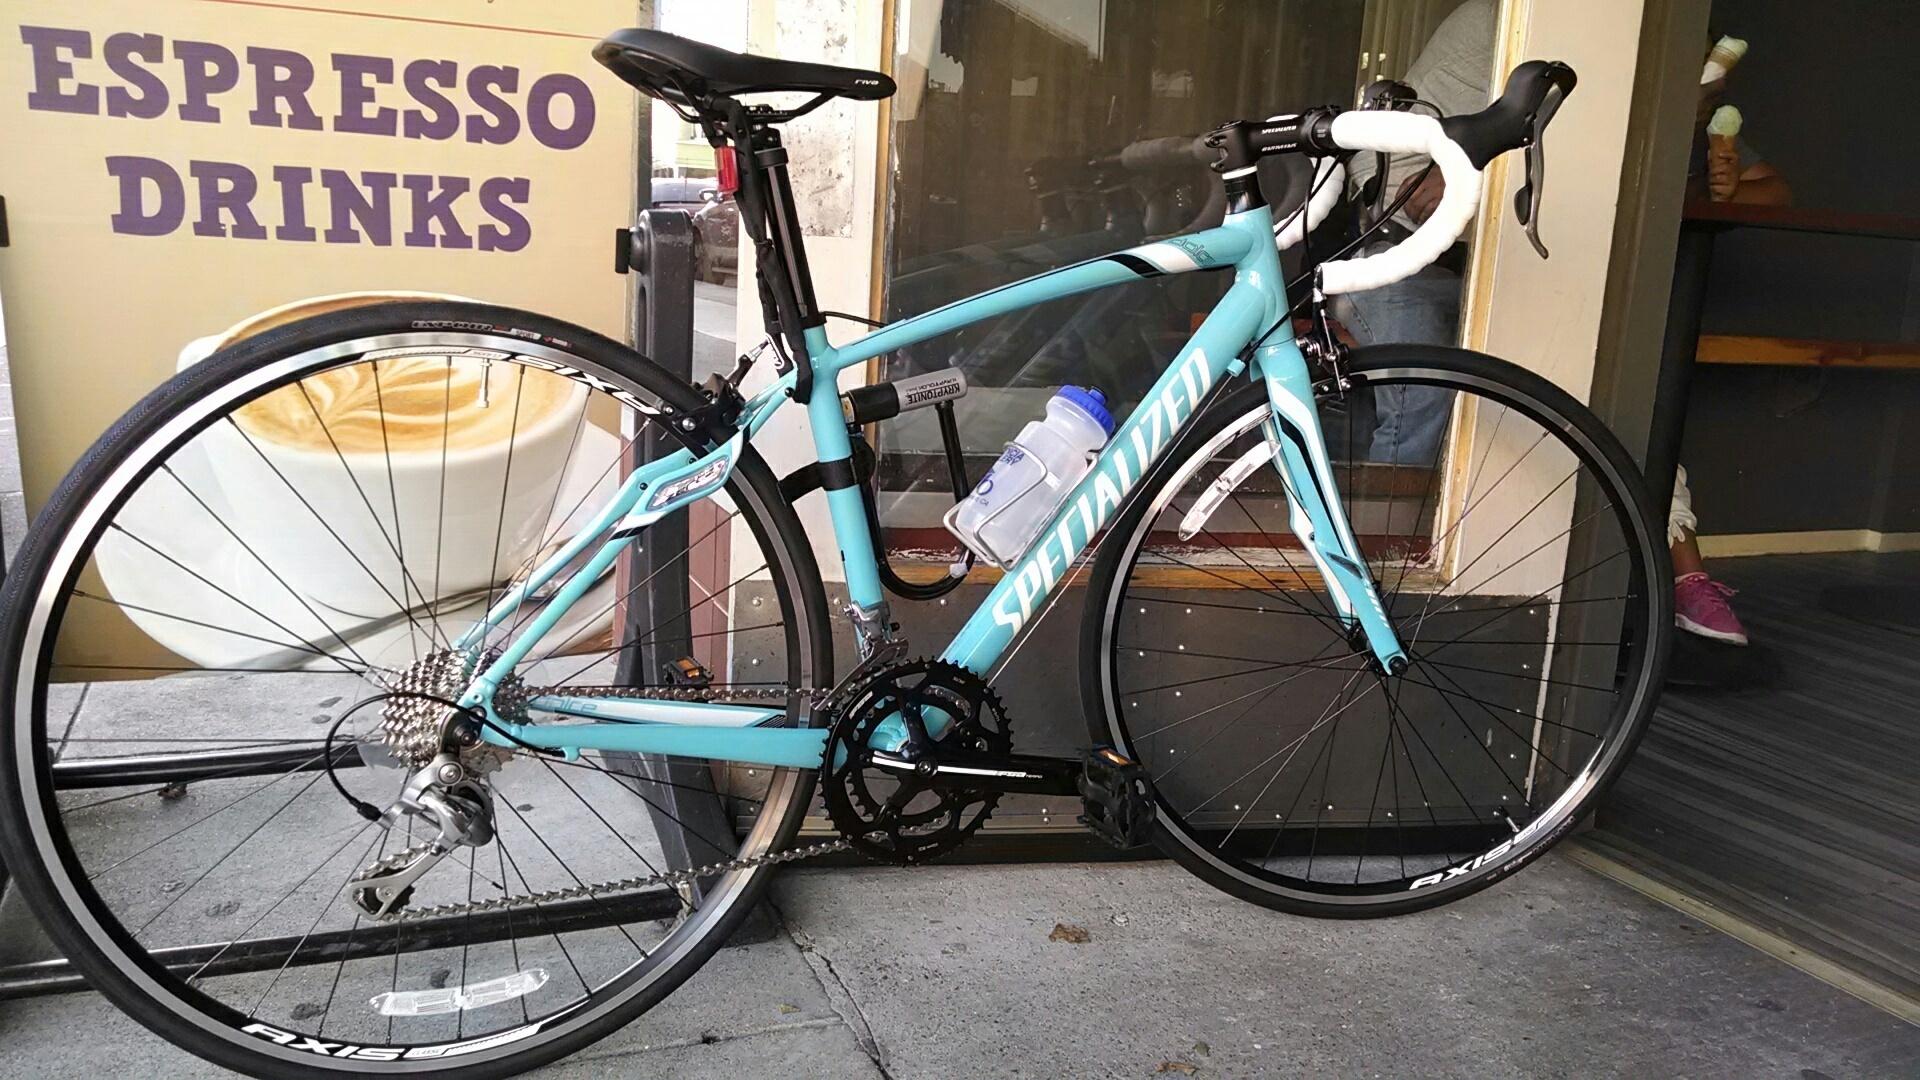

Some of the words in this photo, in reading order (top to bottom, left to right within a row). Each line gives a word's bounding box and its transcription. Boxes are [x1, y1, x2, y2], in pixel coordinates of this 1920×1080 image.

[19, 25, 596, 150] ESPRESSO
[106, 155, 532, 253] DRINKS
[906, 382, 961, 405] KRYPTONITE
[992, 347, 1212, 635] SPECIALIZED
[1409, 839, 1513, 890] AXIS
[242, 1023, 405, 1061] AXIS
